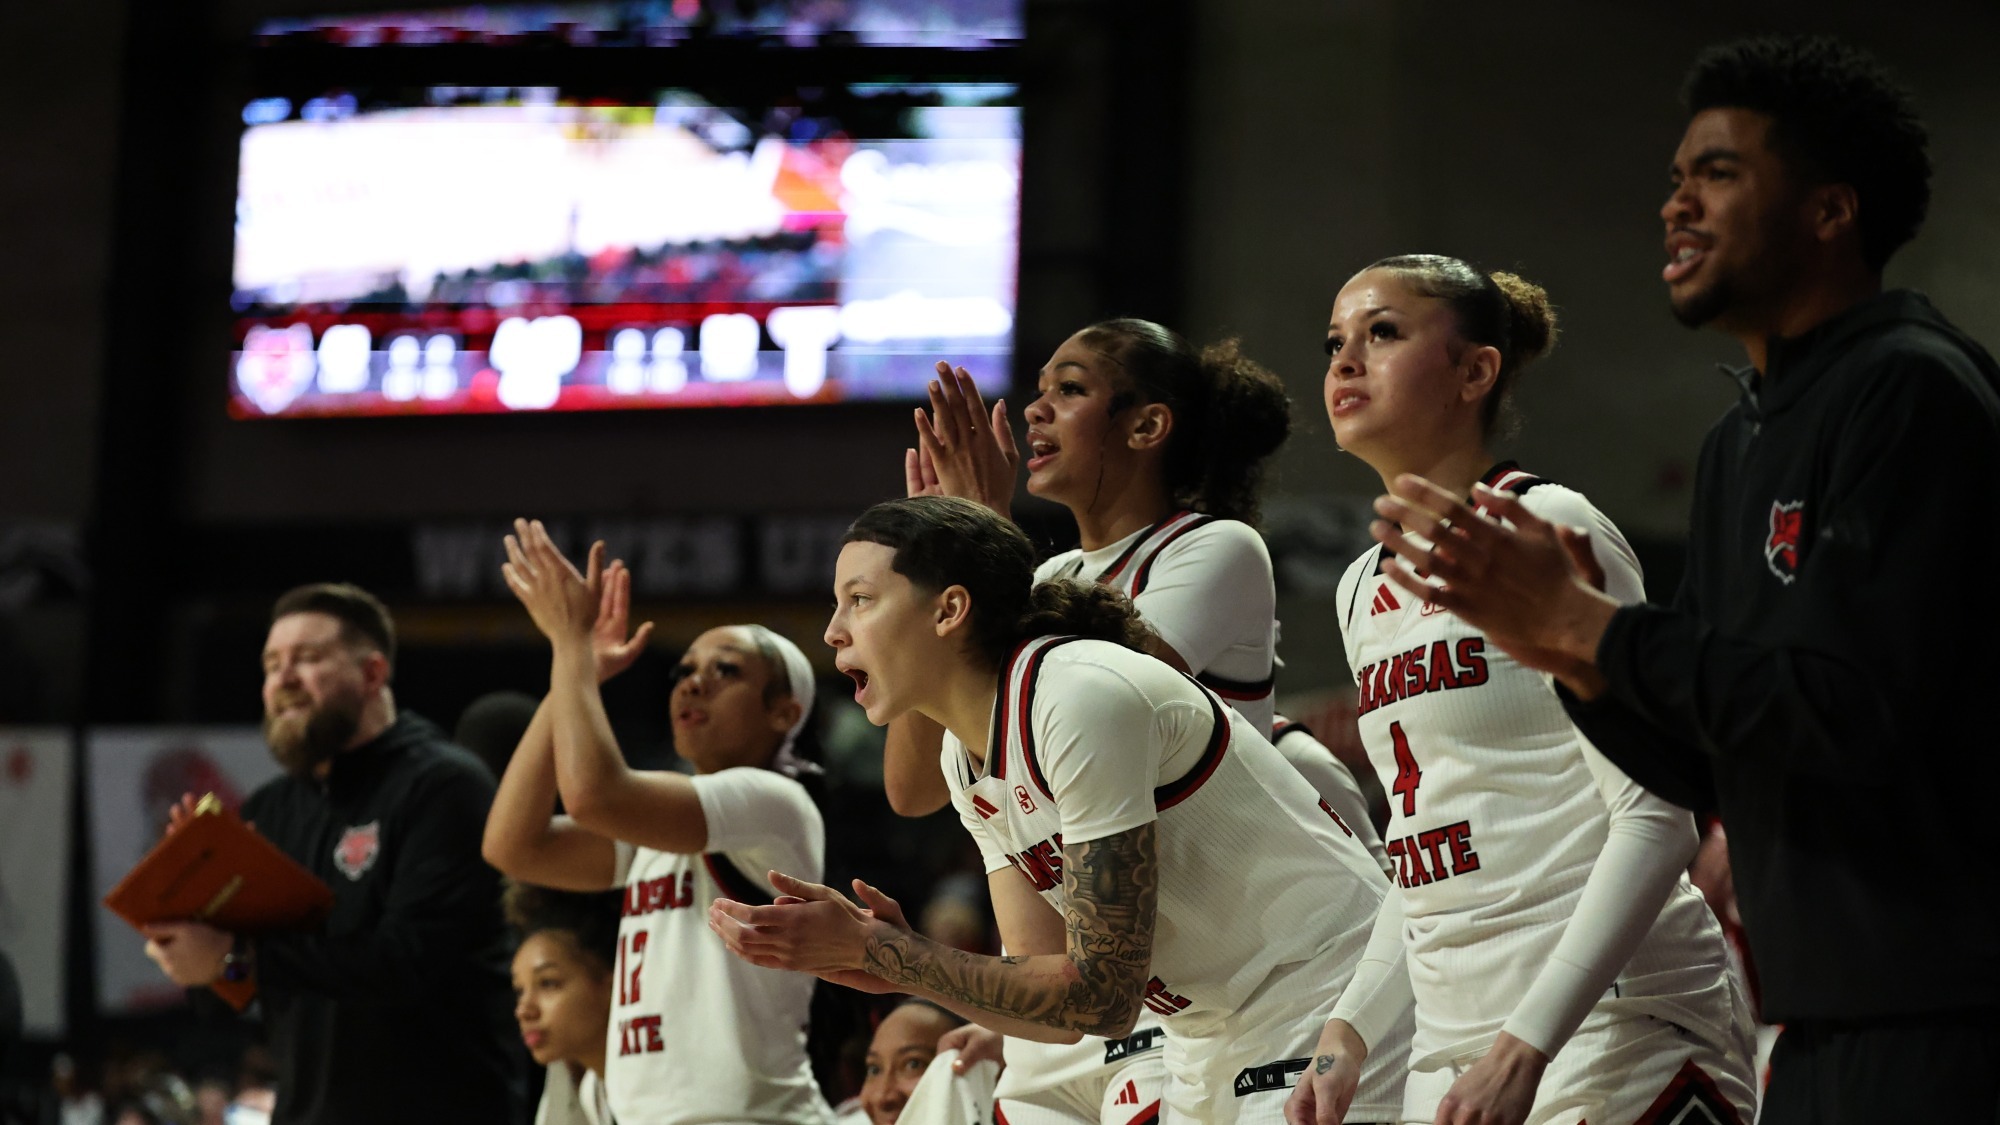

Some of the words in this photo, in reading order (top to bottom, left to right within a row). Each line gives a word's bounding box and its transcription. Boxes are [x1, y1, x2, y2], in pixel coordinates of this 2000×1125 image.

[1358, 637, 1488, 717] KANSAS
[1390, 721, 1422, 817] 4
[620, 1014, 663, 1055] ATE
